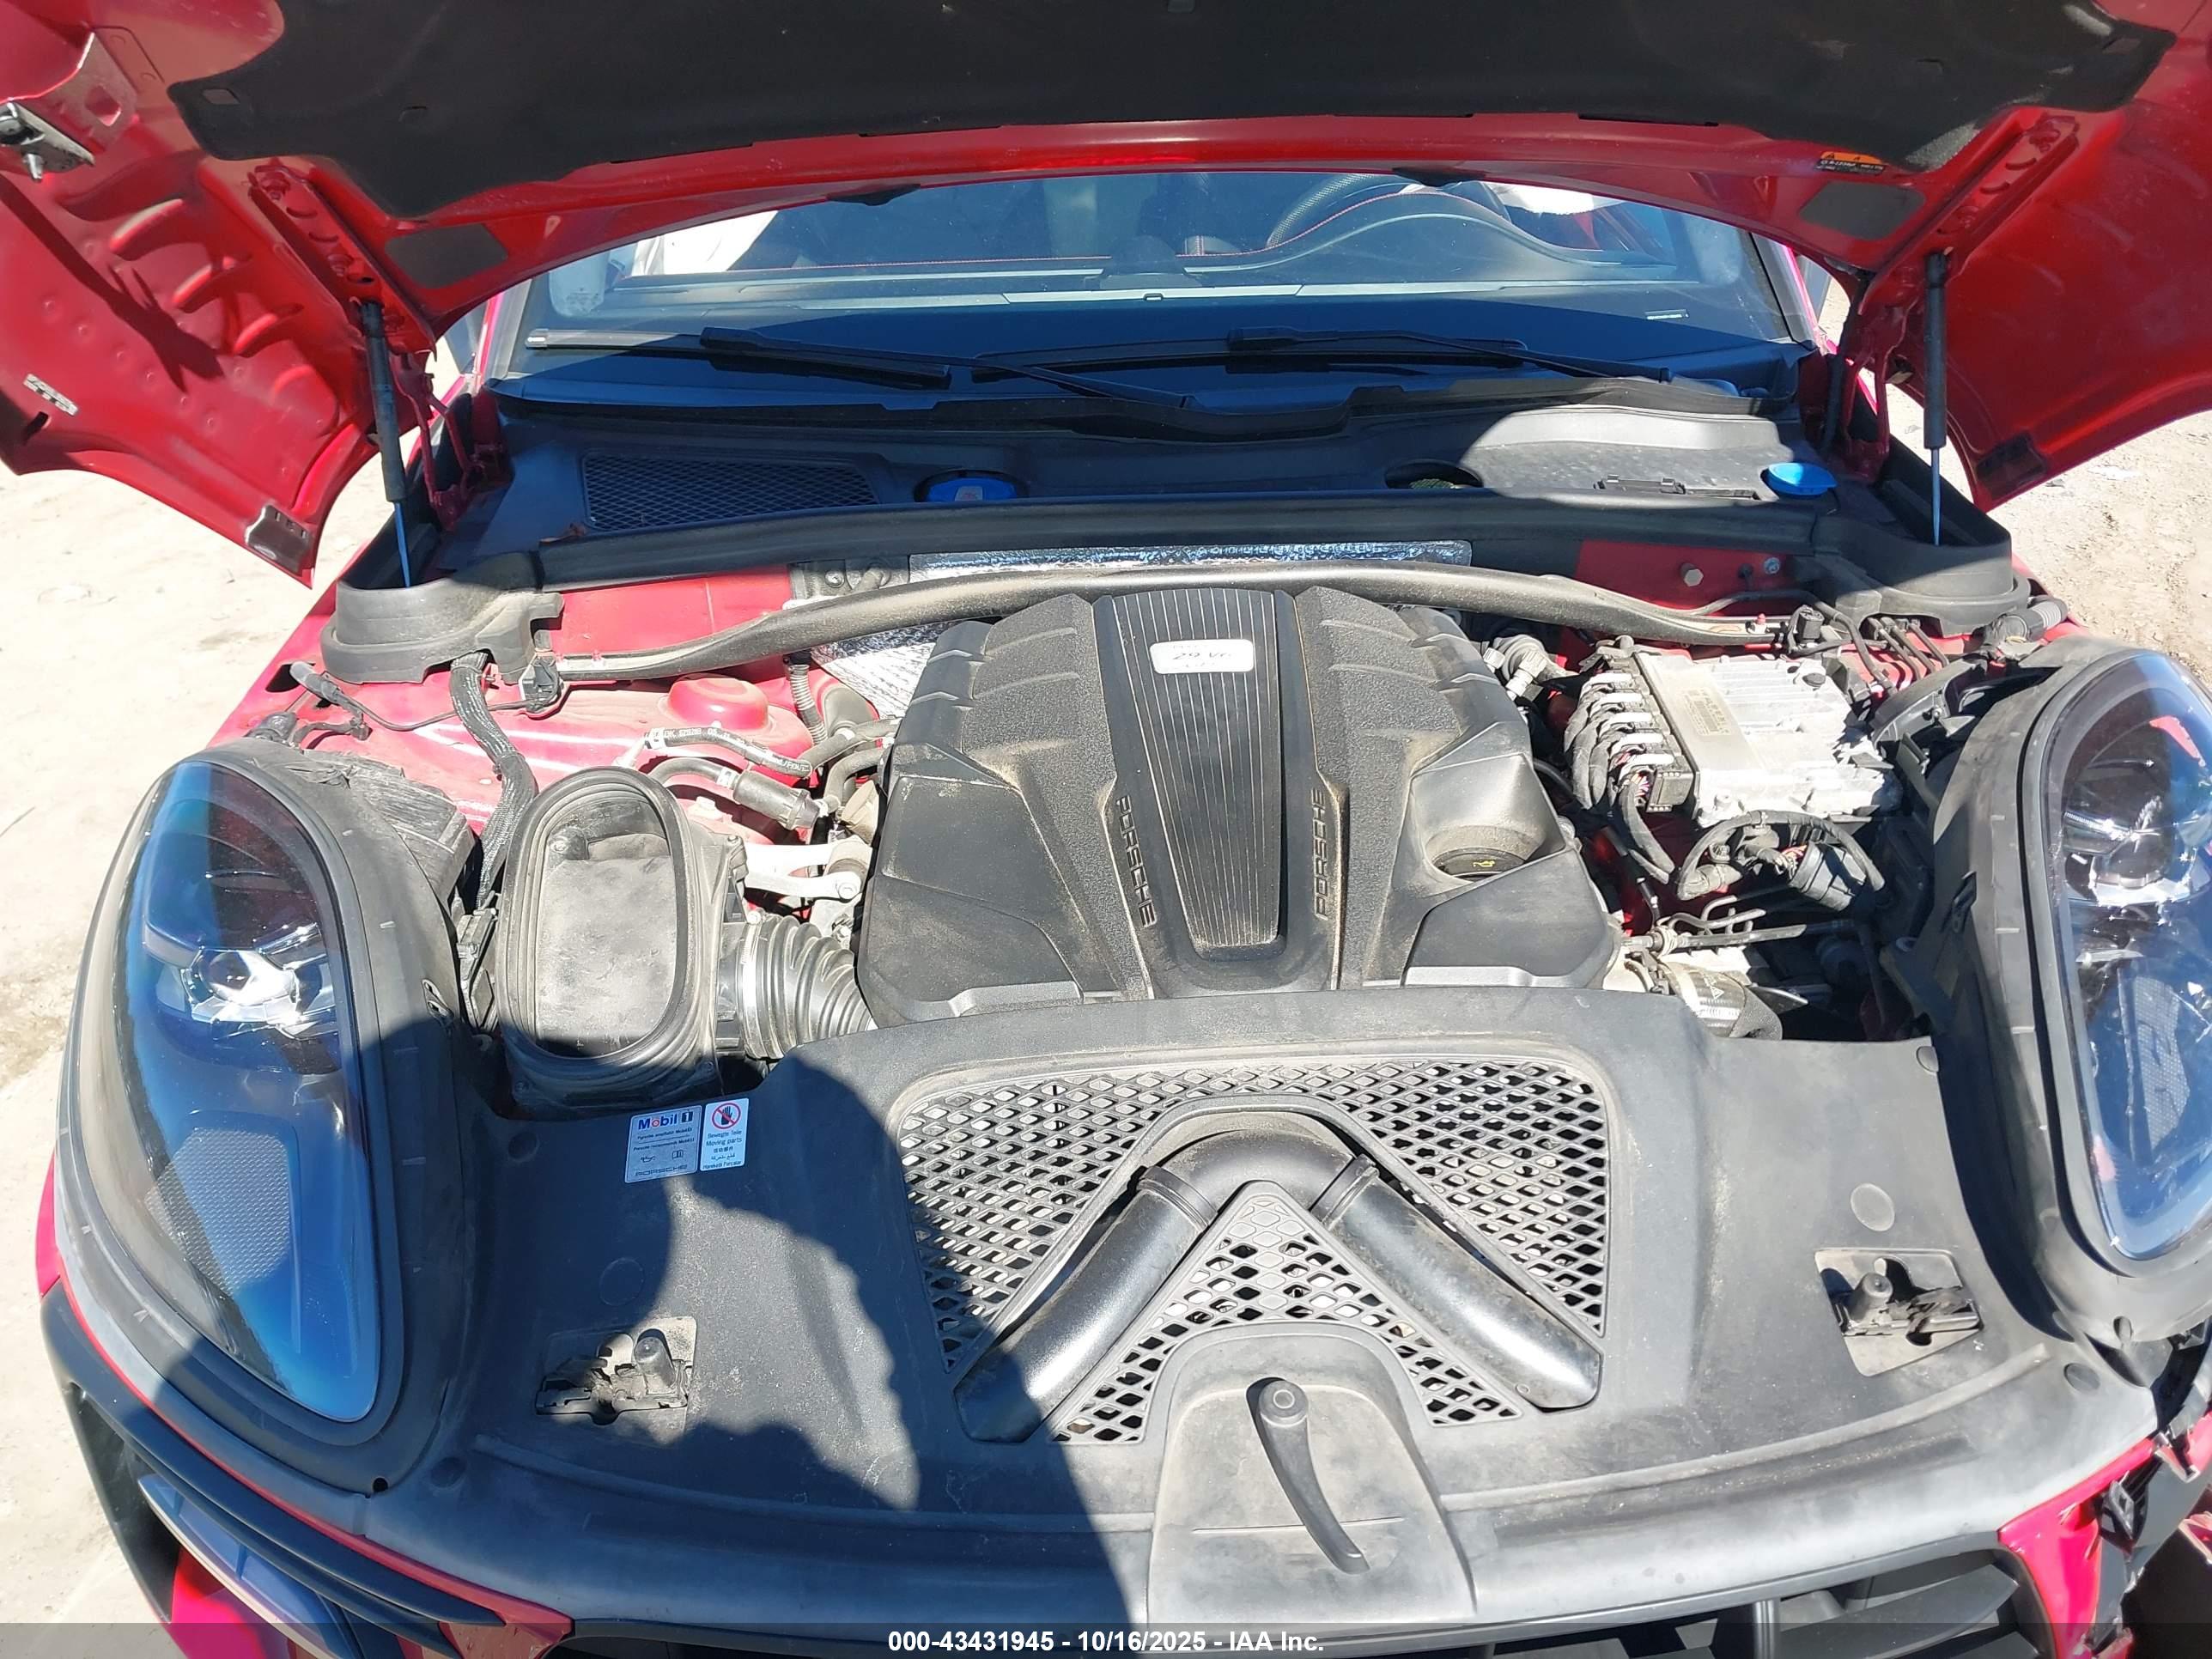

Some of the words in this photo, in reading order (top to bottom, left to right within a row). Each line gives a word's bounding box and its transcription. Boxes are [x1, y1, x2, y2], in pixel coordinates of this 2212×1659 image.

[1116, 794, 1158, 928] PORSCHE
[1311, 788, 1329, 921] PORSCHE
[638, 1113, 678, 1130] Mobil
[635, 1164, 689, 1176] PORSCHE
